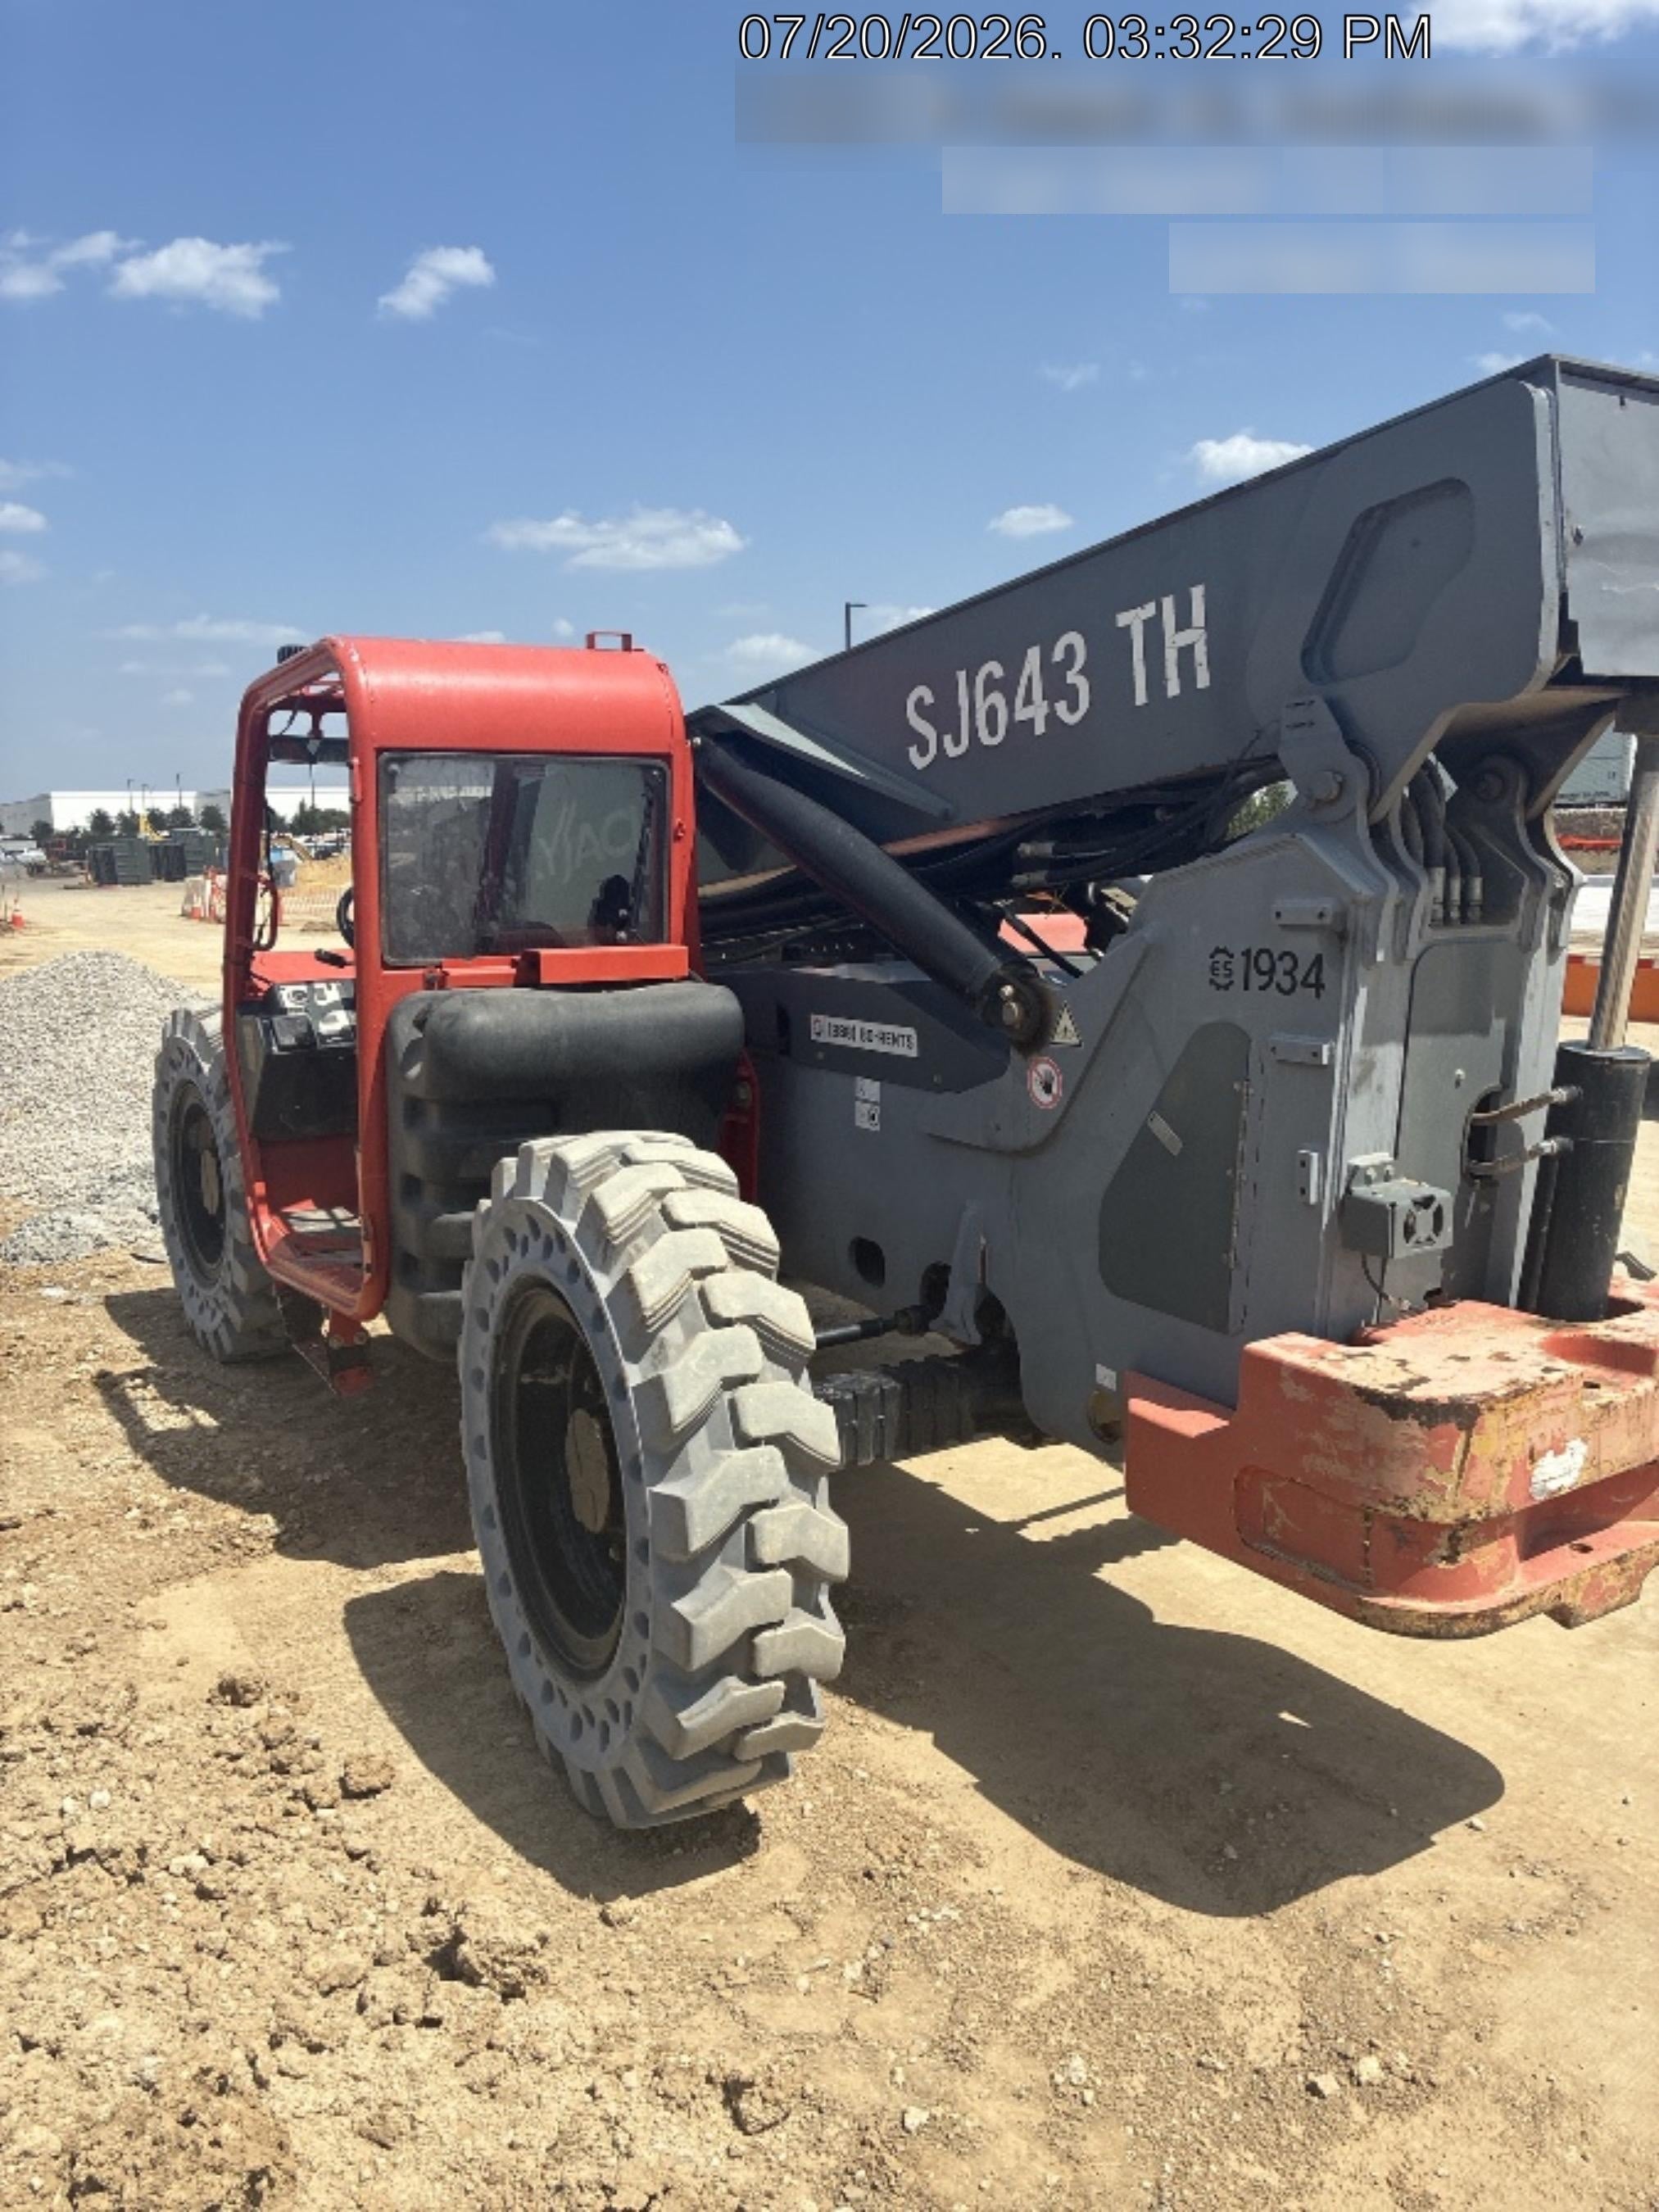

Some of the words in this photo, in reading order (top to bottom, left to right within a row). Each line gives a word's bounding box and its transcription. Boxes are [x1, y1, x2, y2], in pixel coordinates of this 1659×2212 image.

[905, 630, 1090, 770] SJ643
[1115, 583, 1211, 707] TH
[1240, 947, 1326, 1000] 1934
